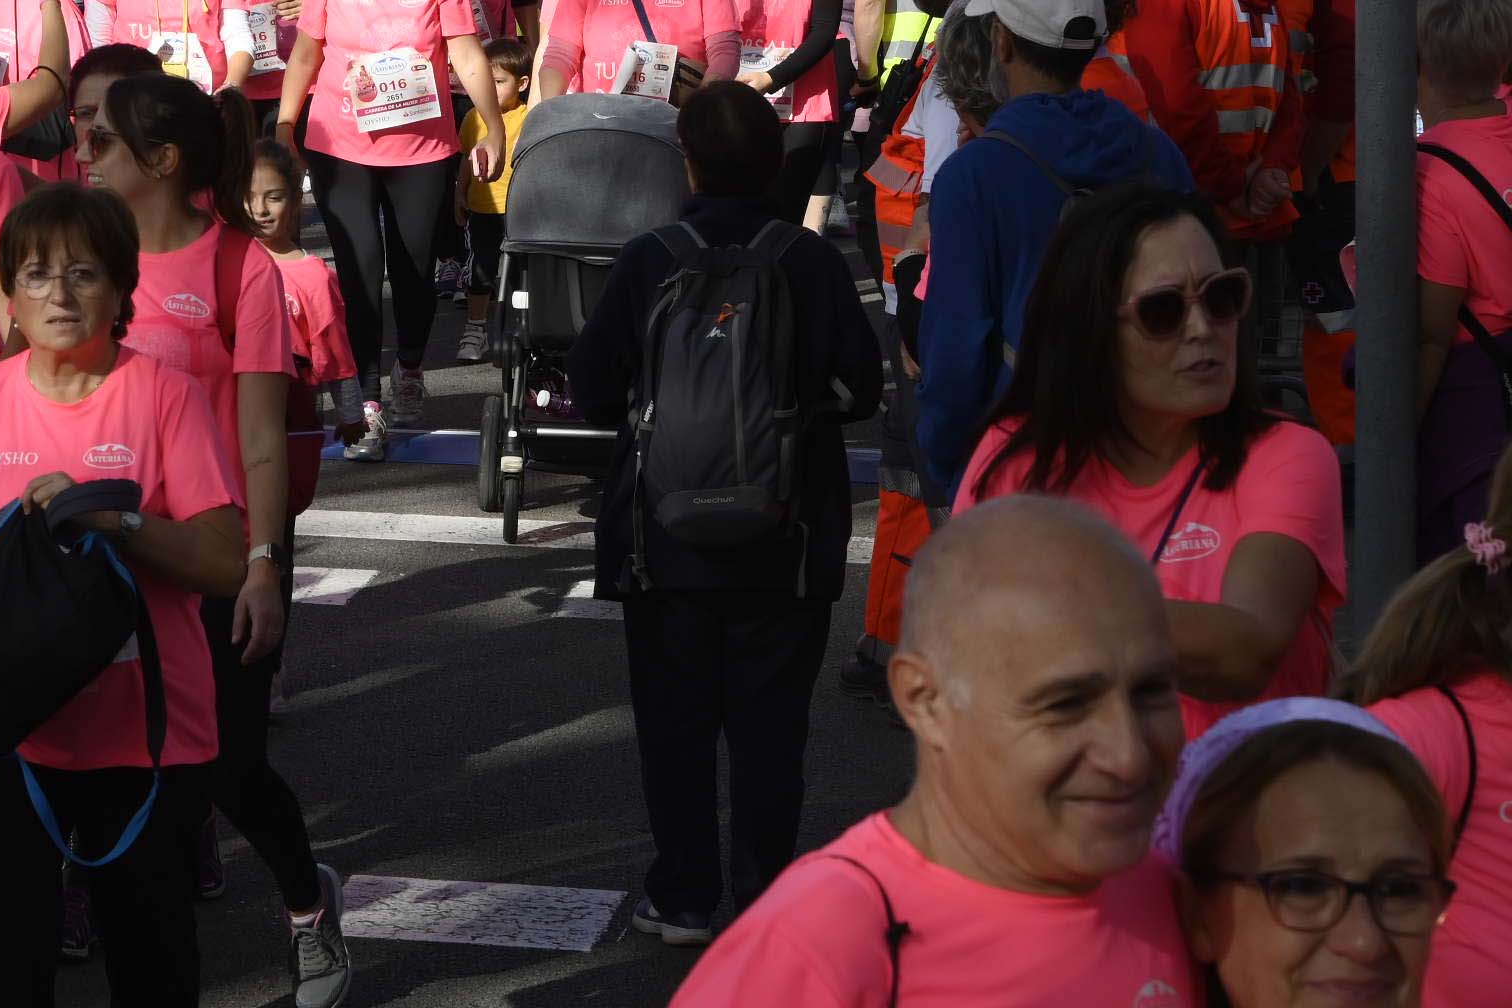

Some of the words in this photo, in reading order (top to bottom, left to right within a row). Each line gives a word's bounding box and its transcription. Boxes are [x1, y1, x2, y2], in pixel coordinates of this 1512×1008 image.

[129, 24, 152, 39] TU
[595, 62, 616, 79] TU
[380, 79, 407, 93] 016
[387, 93, 404, 102] 2651
[87, 453, 131, 464] ASTURIANA
